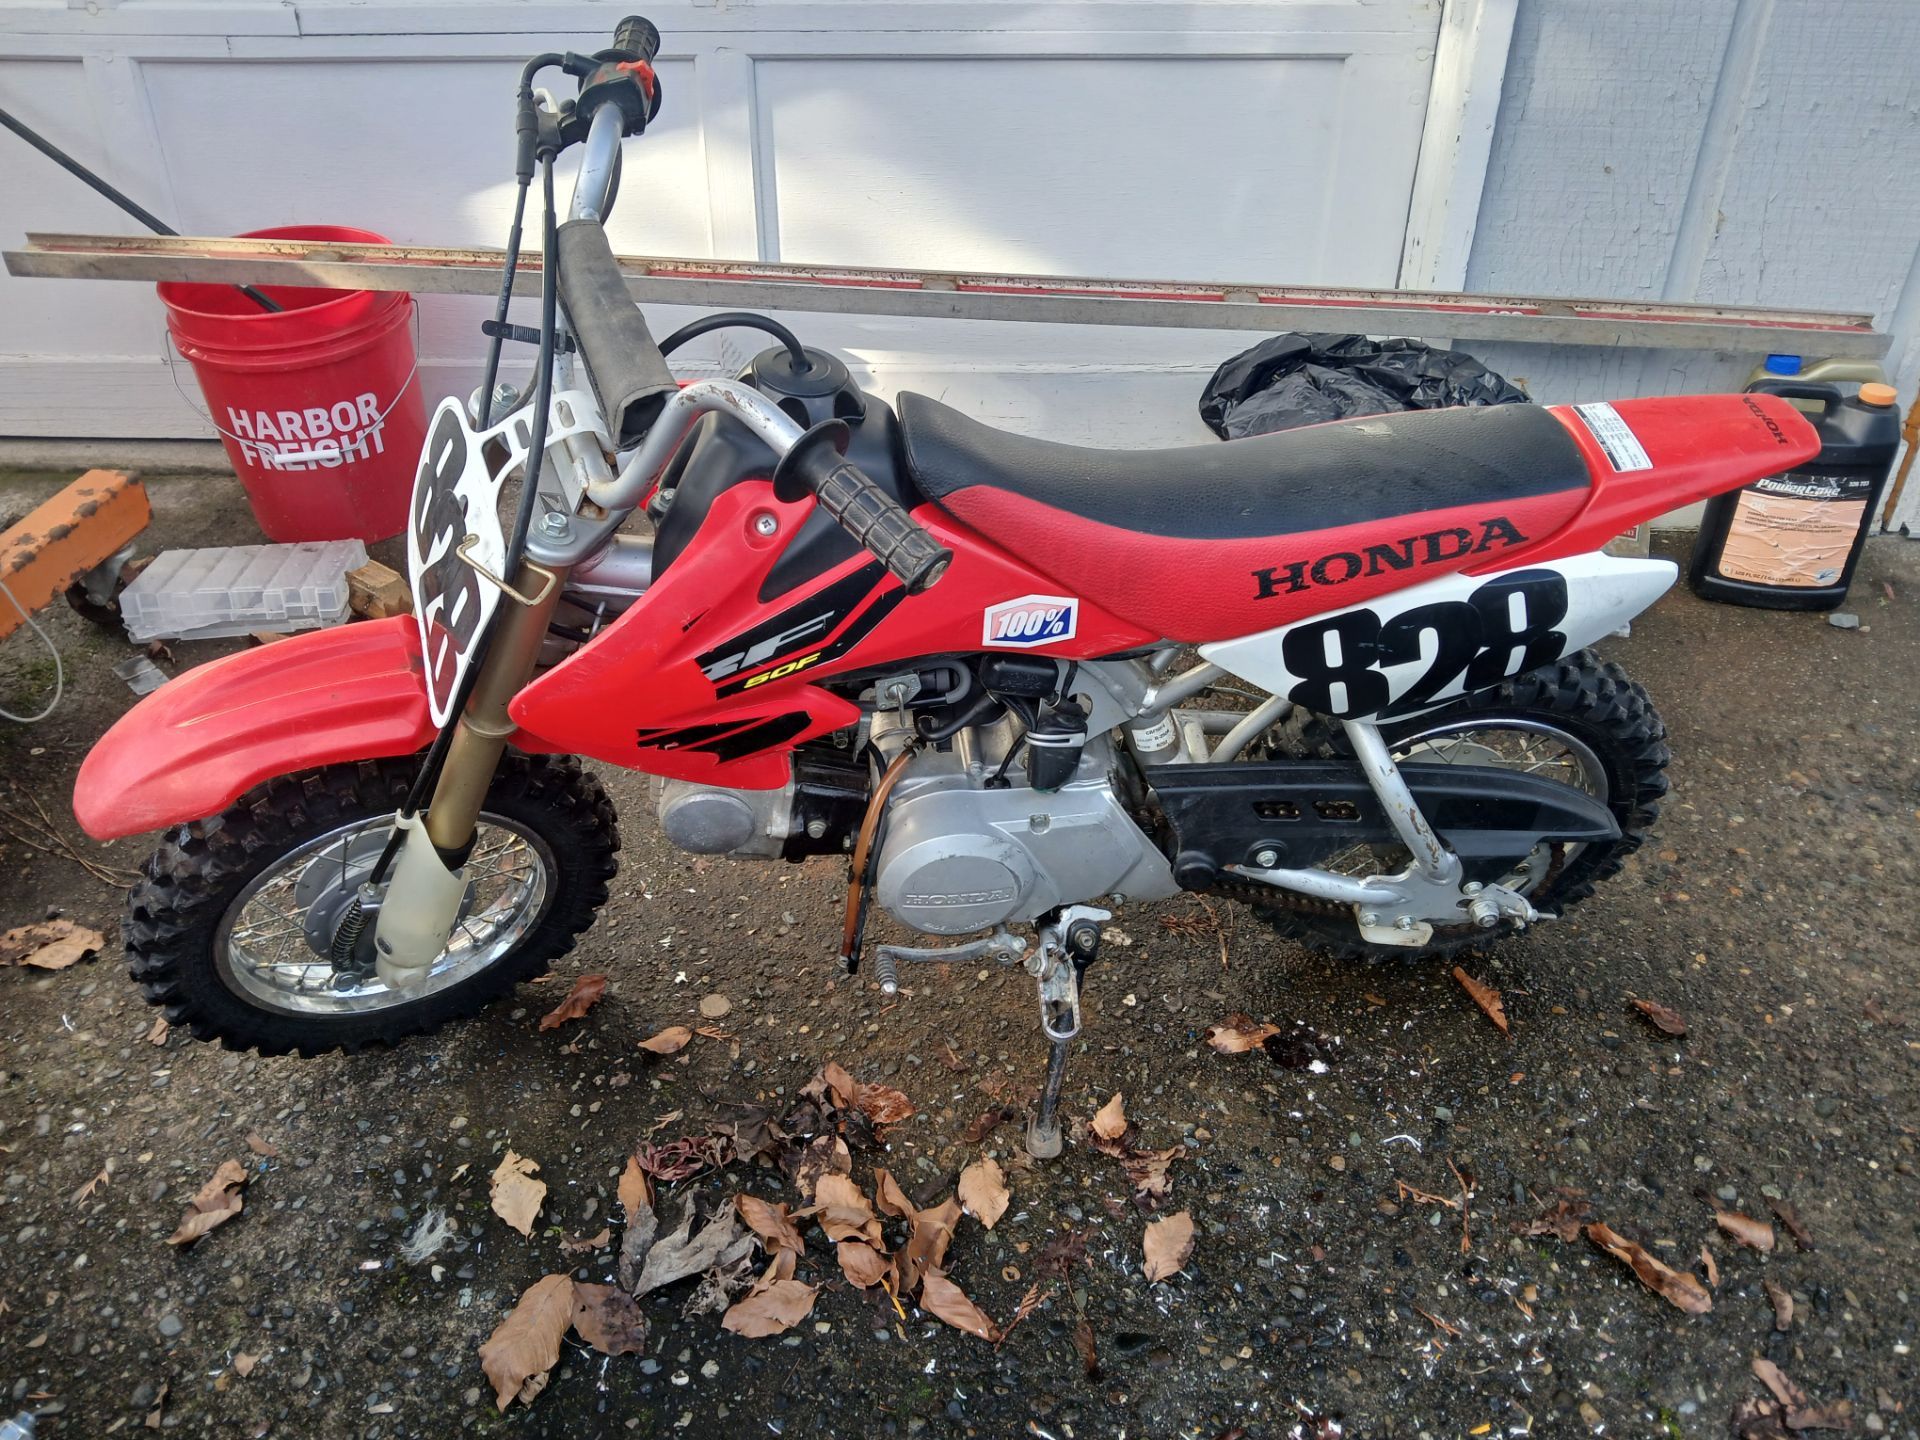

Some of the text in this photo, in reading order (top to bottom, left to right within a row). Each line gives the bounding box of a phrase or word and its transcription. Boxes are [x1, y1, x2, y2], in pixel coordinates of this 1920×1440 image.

[227, 393, 382, 441] HARBOR
[239, 422, 386, 472] FREIGHT
[1252, 516, 1529, 600] HONDA
[996, 608, 1065, 639] 100%
[1282, 569, 1568, 721] 828
[743, 652, 821, 689] 50F
[905, 886, 1015, 905] HONDA
